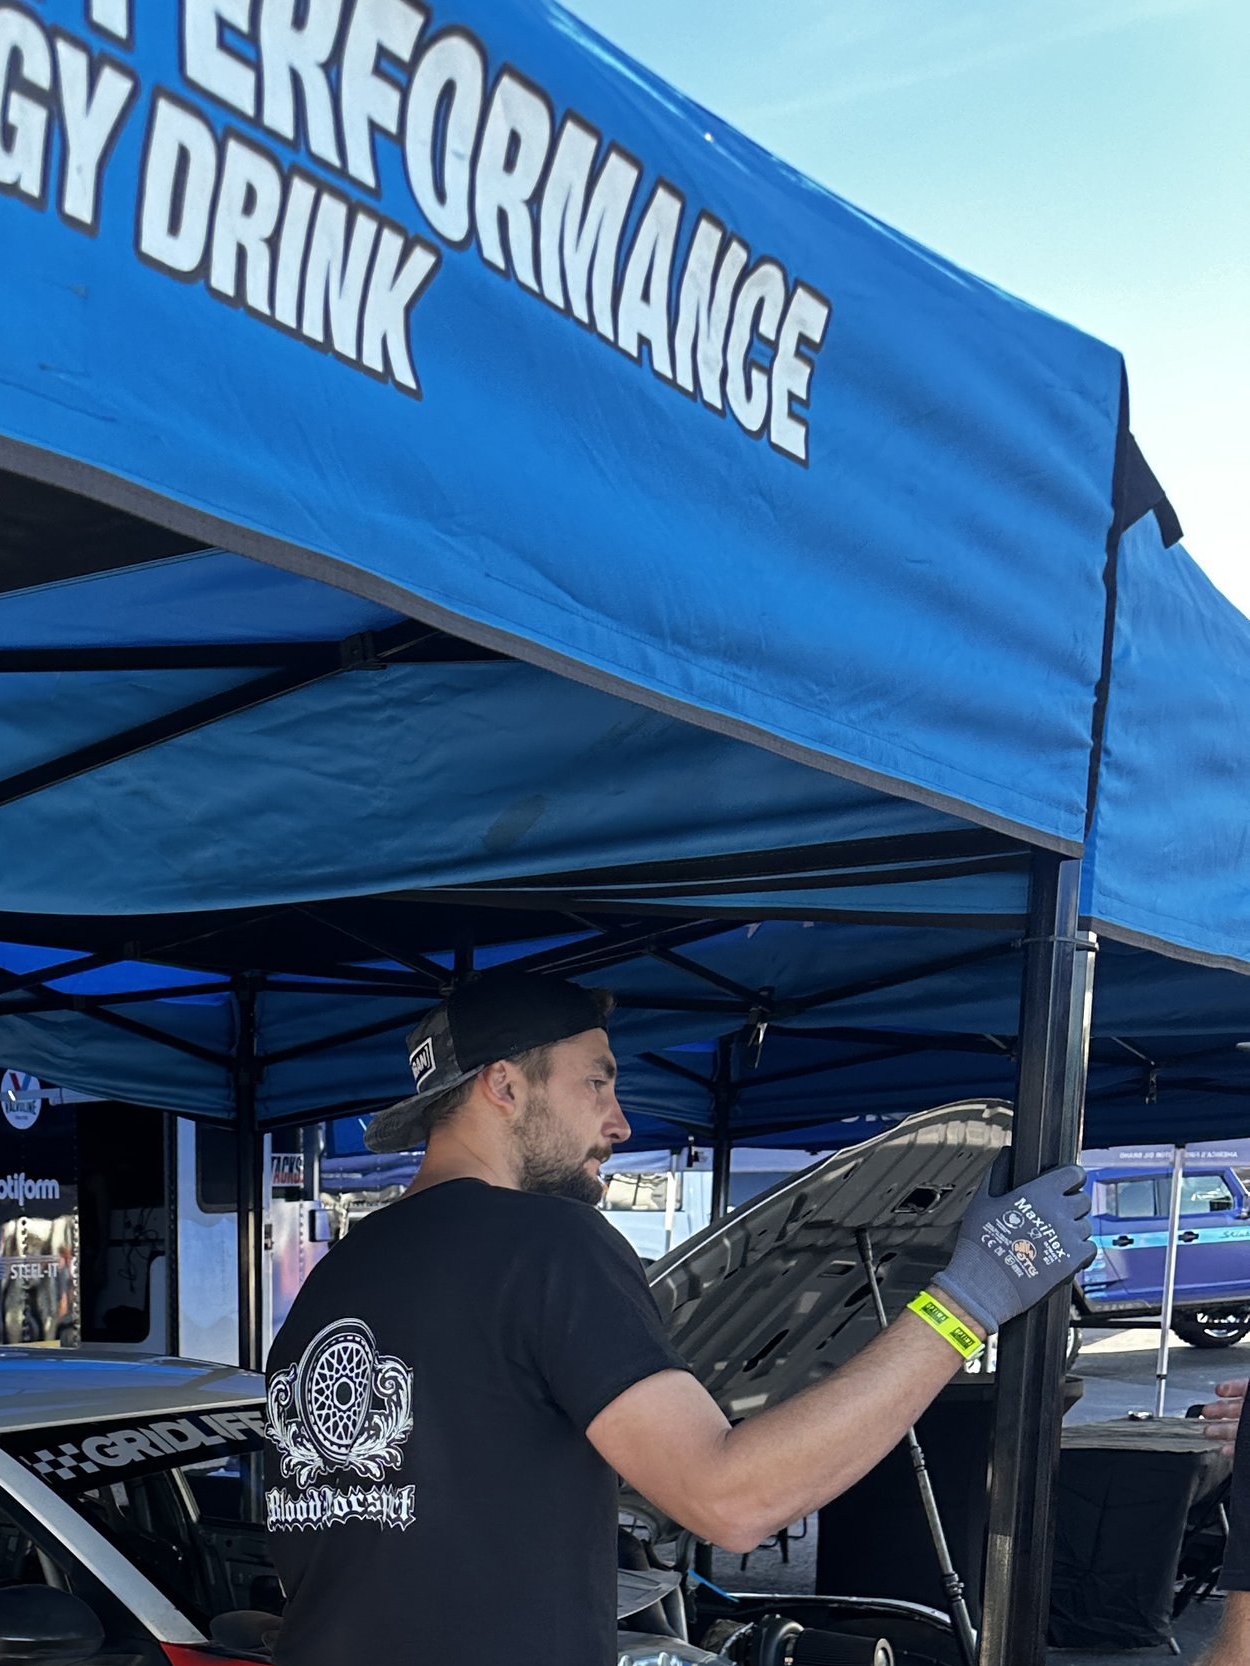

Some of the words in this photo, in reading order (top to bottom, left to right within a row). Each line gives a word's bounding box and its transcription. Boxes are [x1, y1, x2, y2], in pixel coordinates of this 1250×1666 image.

[90, 0, 830, 461] ERFORMANCE
[138, 96, 438, 392] DRINK
[10, 1263, 59, 1280] STEEL-IT
[1014, 1197, 1067, 1259] MaxiFlex
